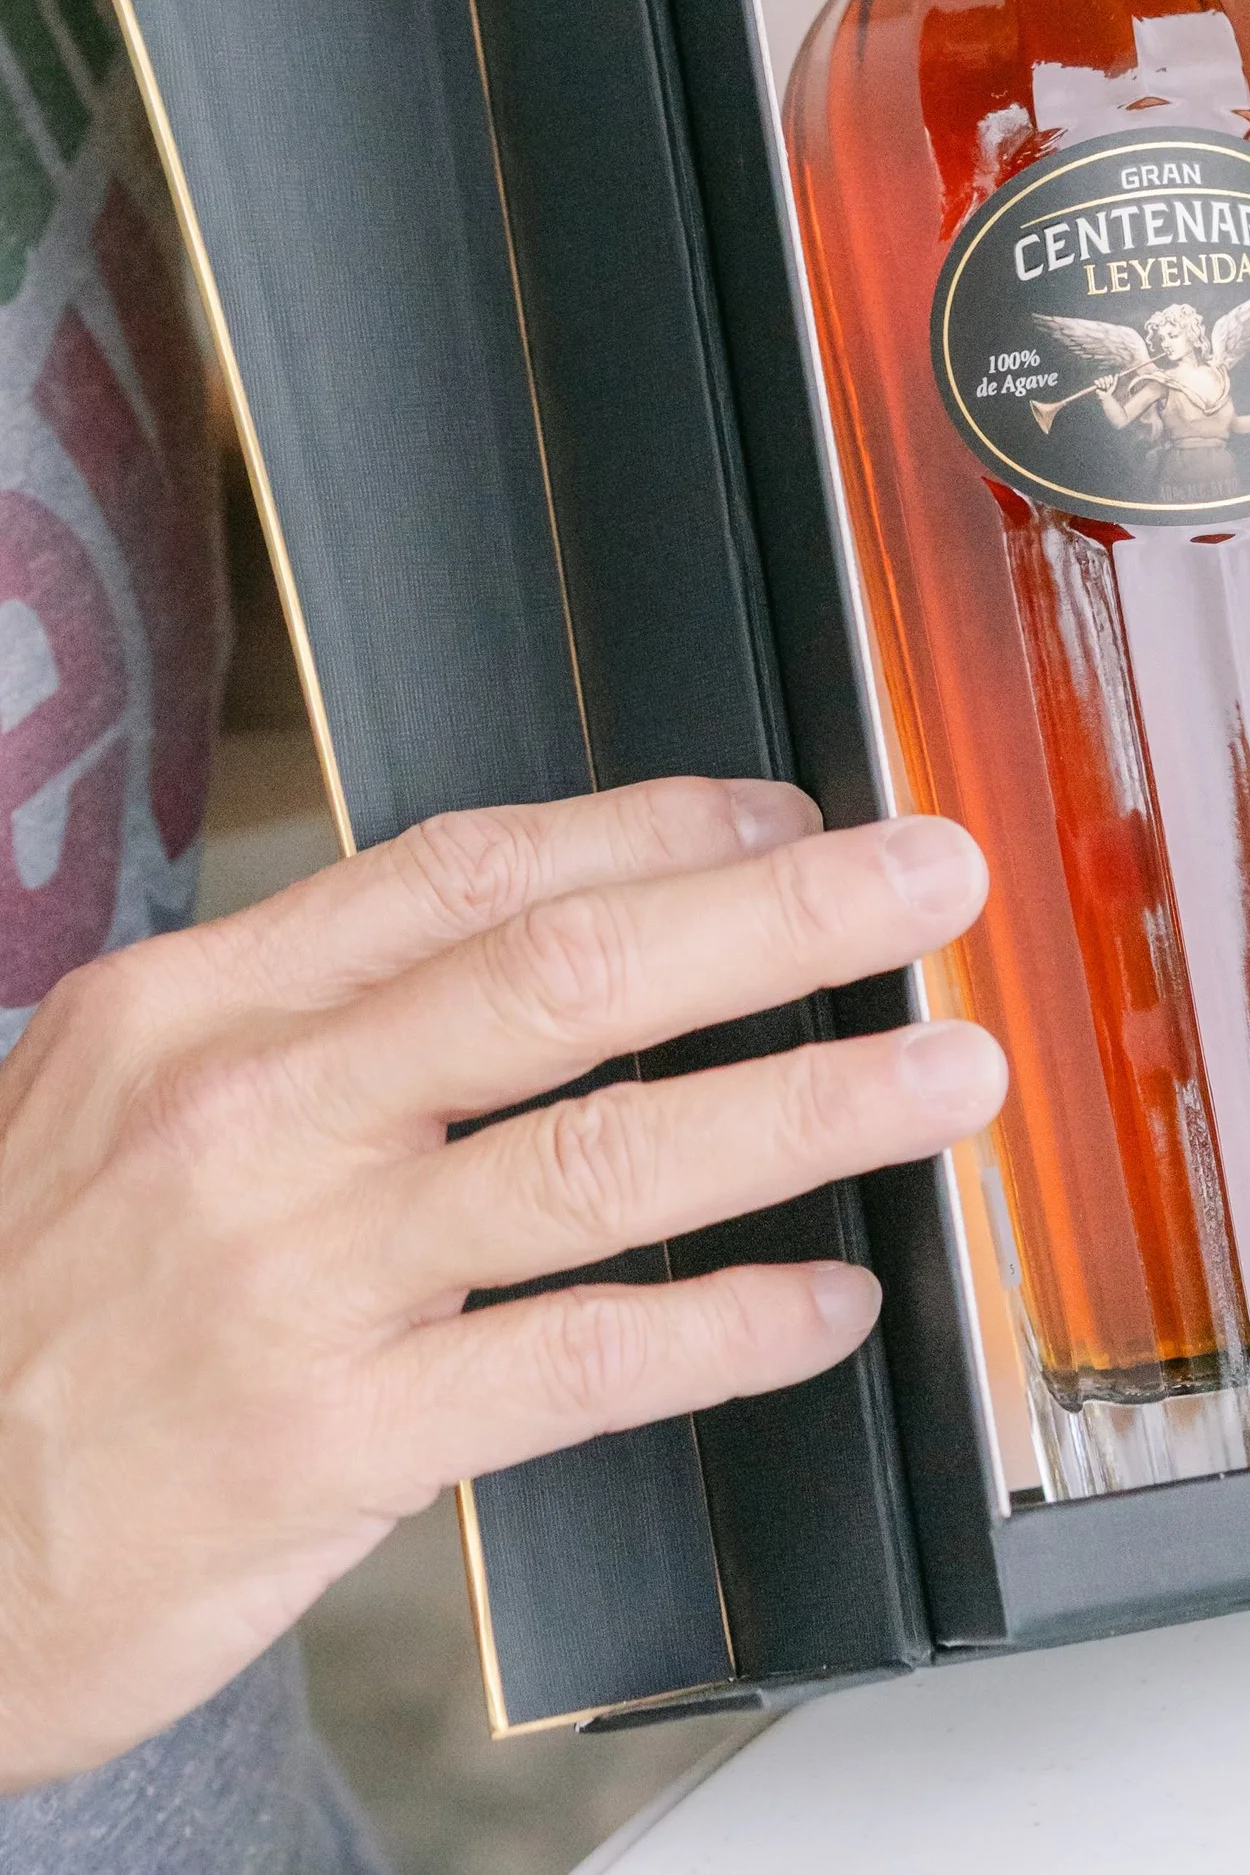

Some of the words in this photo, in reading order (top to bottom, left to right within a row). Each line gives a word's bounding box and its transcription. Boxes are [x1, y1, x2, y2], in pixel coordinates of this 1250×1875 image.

[1121, 164, 1201, 189] GRAN
[988, 349, 1041, 374] 100%
[976, 376, 998, 398] de
[1000, 372, 1059, 397] Agave
